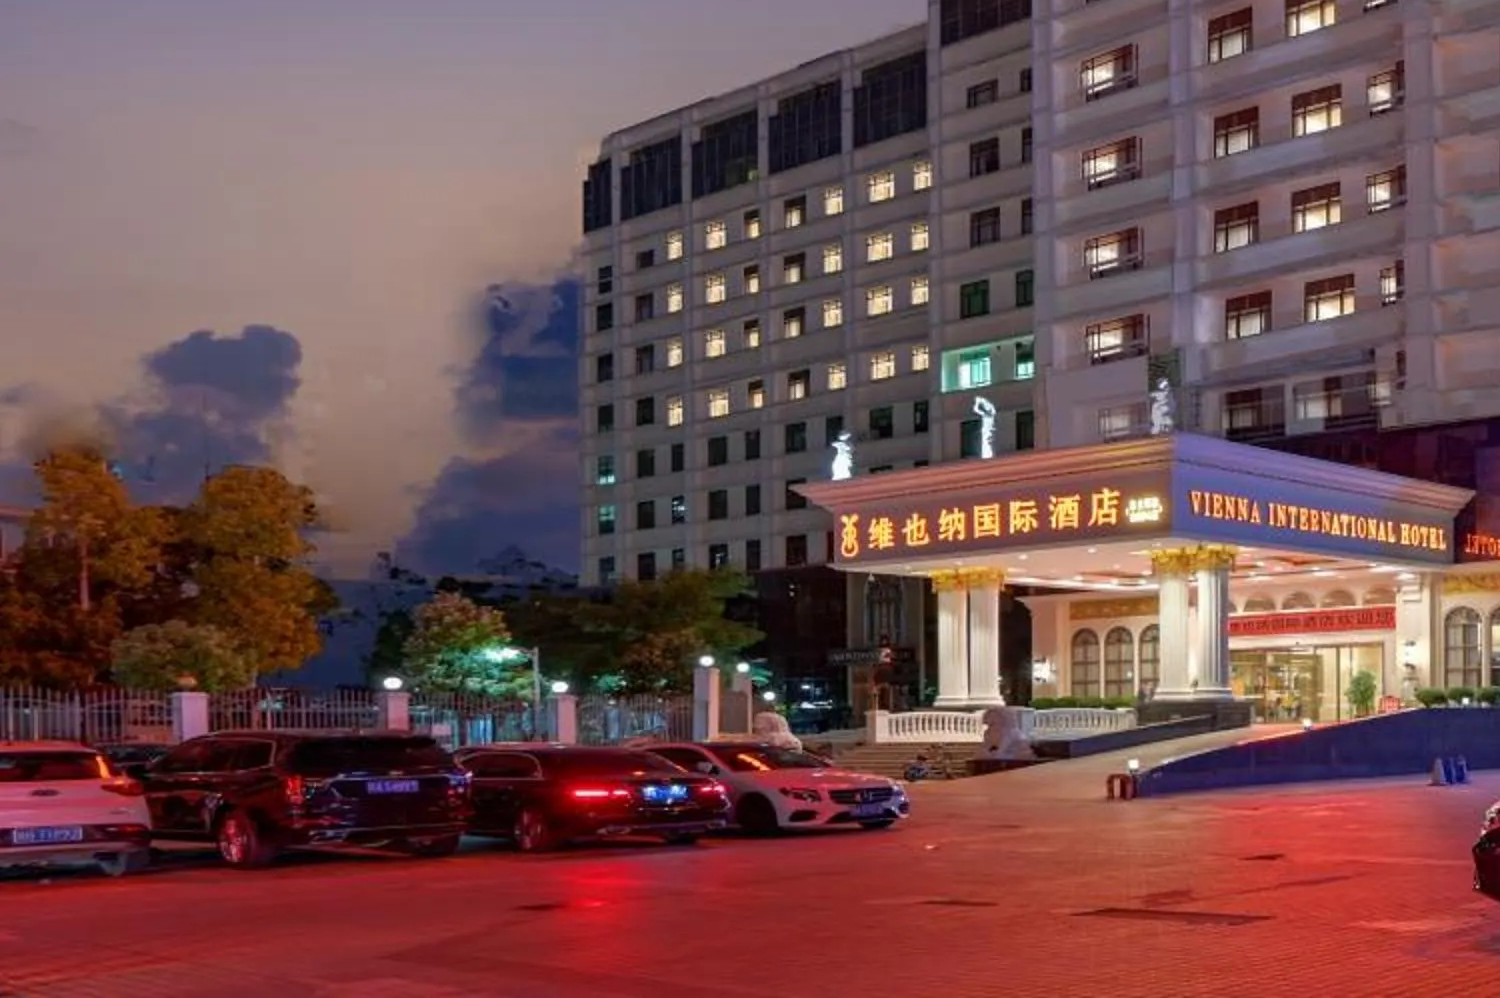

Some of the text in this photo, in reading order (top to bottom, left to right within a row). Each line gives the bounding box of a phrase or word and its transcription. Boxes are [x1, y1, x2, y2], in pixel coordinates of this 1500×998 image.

[868, 488, 1121, 550] 维也纳国际酒店
[1190, 490, 1261, 524] VIENNA
[1268, 502, 1397, 544] INTERNATIONAL
[1400, 522, 1447, 551] HOTEL
